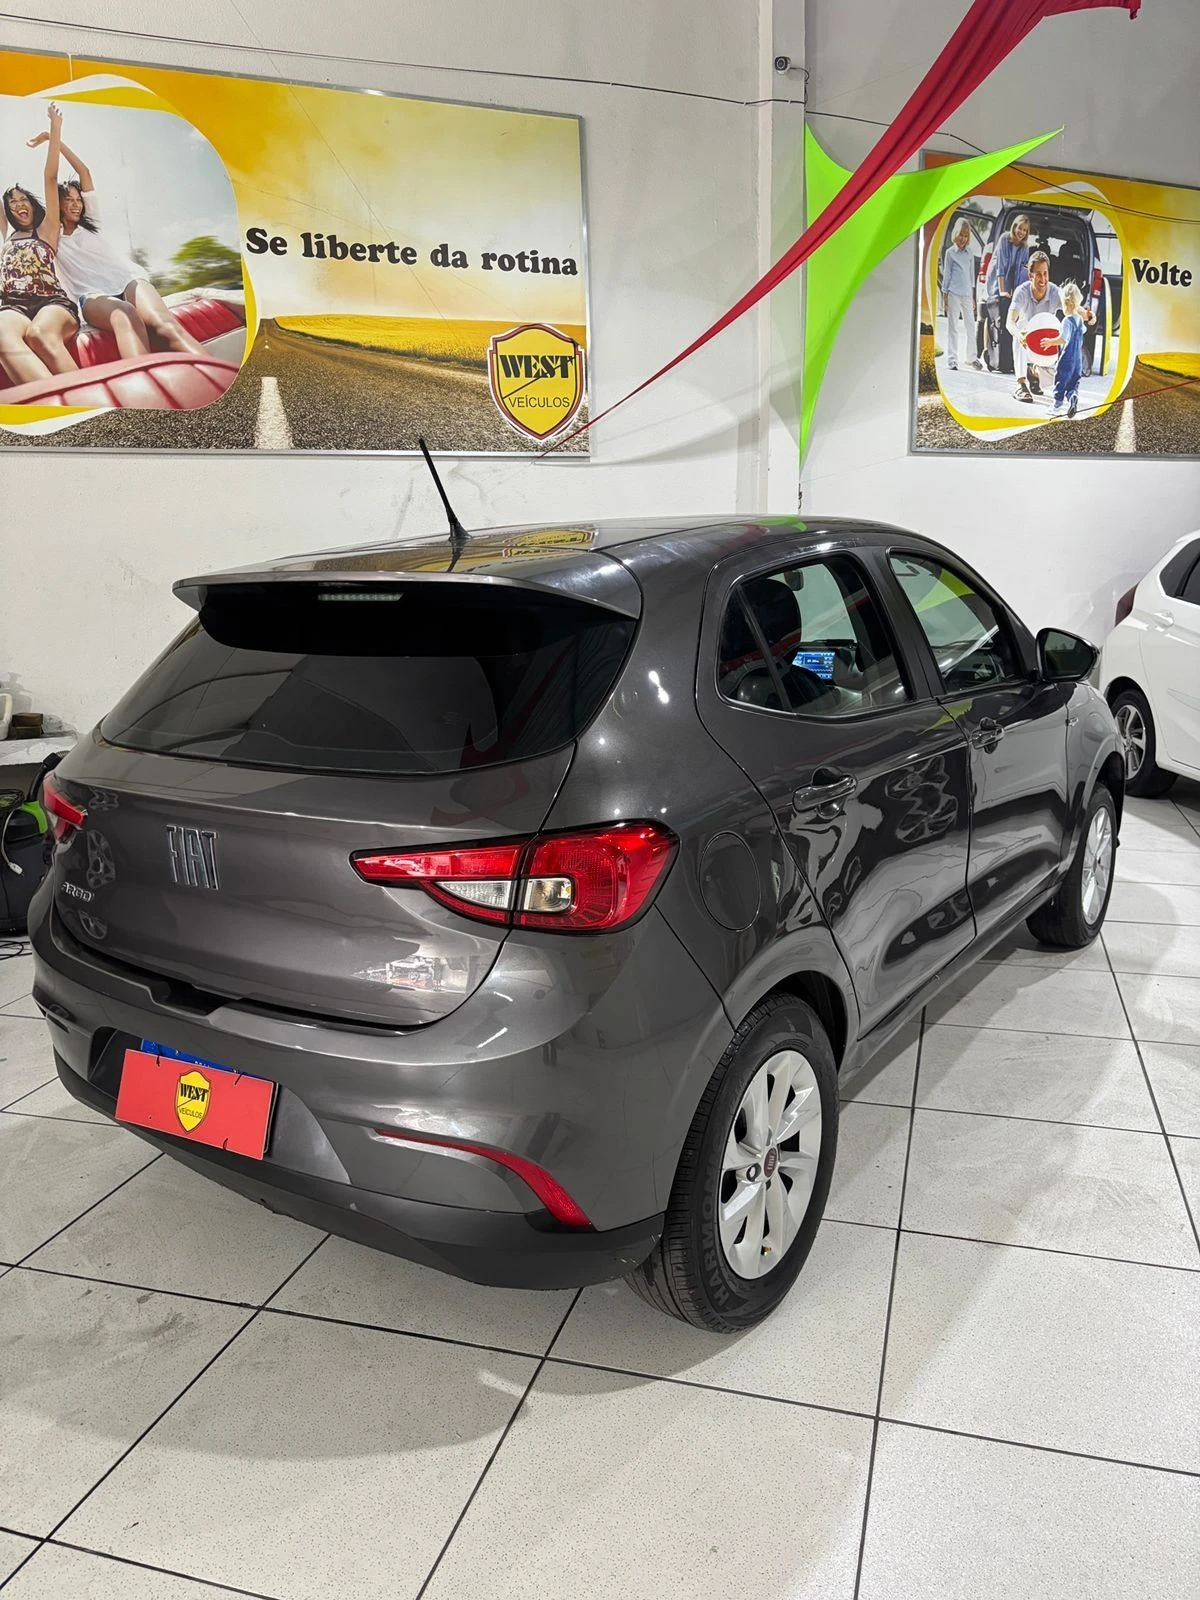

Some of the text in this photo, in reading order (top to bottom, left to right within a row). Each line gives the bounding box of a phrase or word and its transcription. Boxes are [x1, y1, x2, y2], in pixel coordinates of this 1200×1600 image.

[246, 228, 578, 276] Se liberte da rotina
[1131, 258, 1192, 287] Volte
[499, 354, 575, 379] WEST
[508, 393, 570, 409] VEÍCULOS
[166, 824, 219, 890] FIAT
[61, 881, 93, 903] ARGO
[180, 1083, 209, 1102] WEST
[699, 1153, 730, 1307] HARMON
